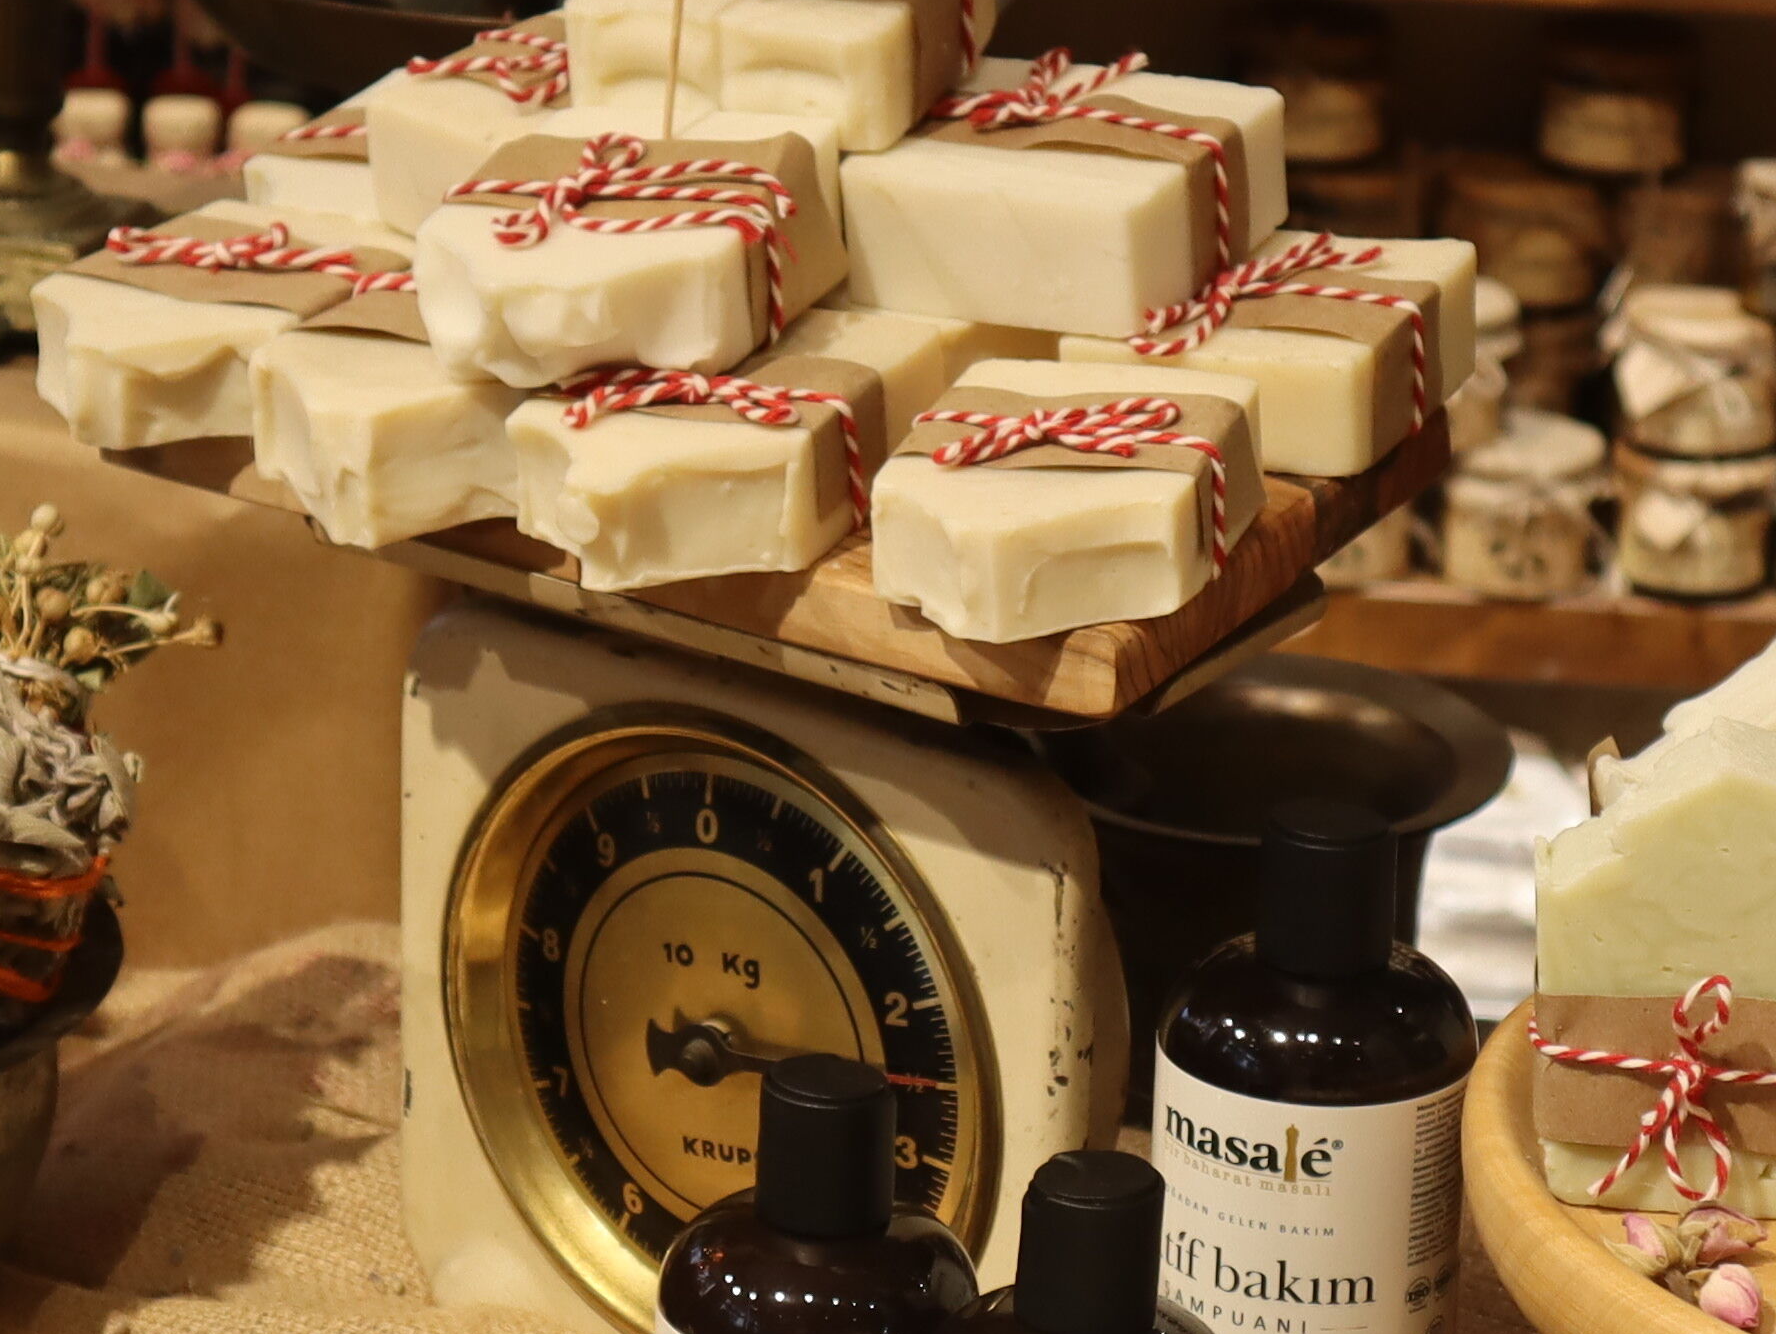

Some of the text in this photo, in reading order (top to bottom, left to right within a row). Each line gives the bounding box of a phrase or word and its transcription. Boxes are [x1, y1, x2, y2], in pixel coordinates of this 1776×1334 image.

[695, 808, 719, 844] 0
[596, 832, 617, 867] 9
[808, 867, 824, 904] 1
[661, 942, 761, 990] 10 Kg
[884, 991, 909, 1027] 2
[682, 1135, 759, 1167] KRUP
[623, 1183, 645, 1216] 6
[1279, 1224, 1337, 1238] BAKIM
[1212, 1246, 1377, 1306] bakım
